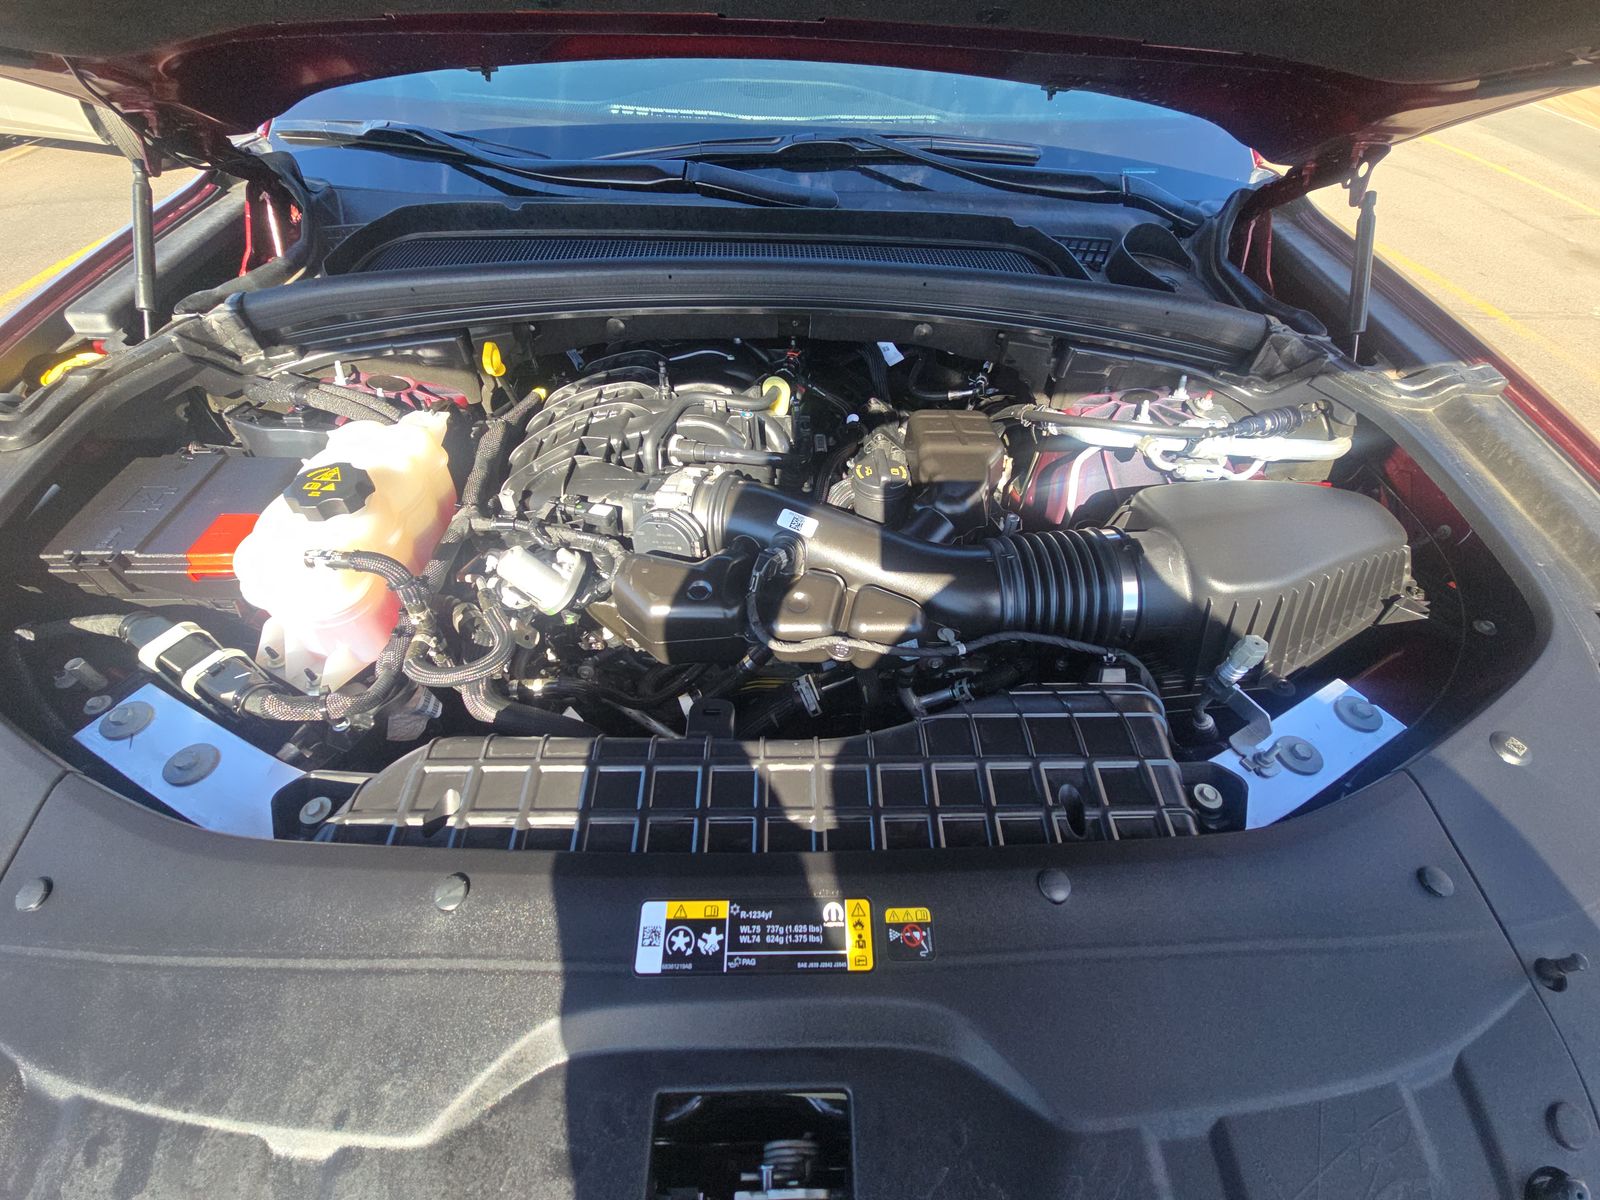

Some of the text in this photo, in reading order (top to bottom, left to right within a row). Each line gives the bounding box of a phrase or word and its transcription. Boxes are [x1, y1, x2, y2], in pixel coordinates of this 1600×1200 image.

[766, 925, 784, 935] 737g
[785, 924, 807, 934] (1.625
[808, 924, 822, 934] lbs)
[739, 934, 761, 943] WL74
[785, 934, 808, 944] (1.375
[808, 934, 823, 944] lbs)
